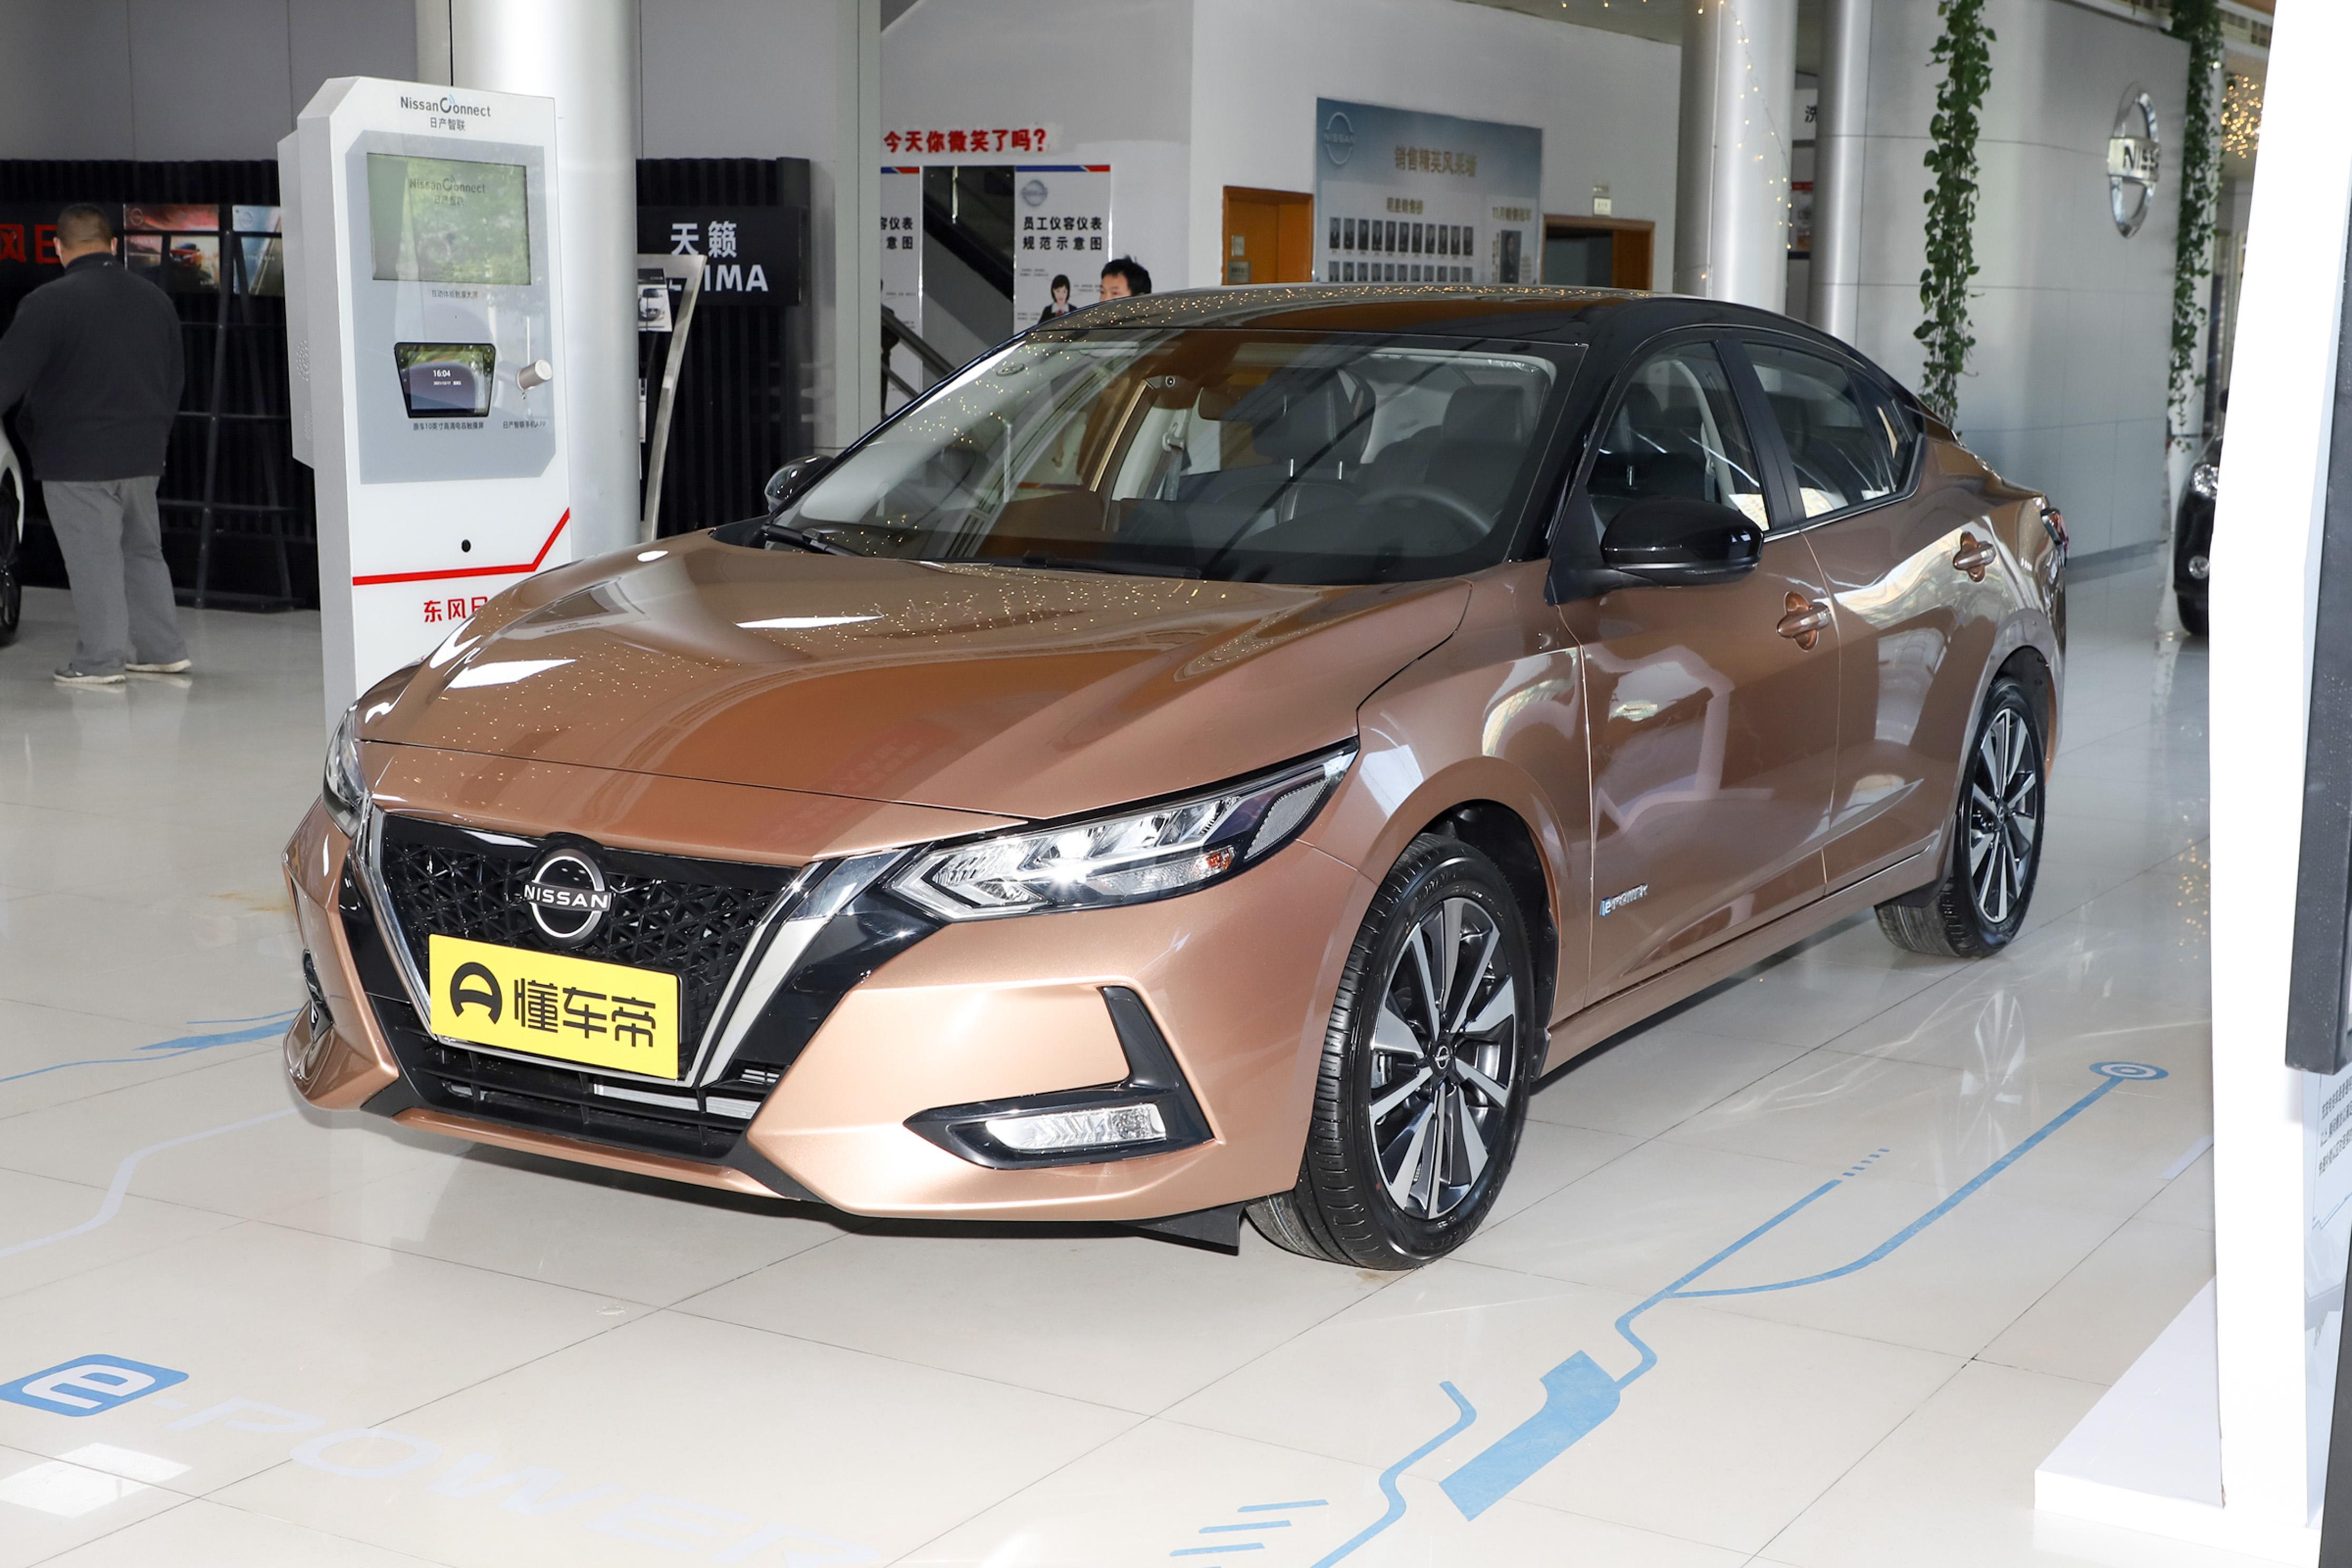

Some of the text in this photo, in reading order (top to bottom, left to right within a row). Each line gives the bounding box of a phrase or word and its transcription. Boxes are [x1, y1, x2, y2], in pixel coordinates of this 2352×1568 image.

[400, 96, 491, 117] NissanConnect
[430, 117, 465, 131] 日产智联
[884, 128, 1046, 153] 今天你微笑了吗？
[409, 178, 486, 193] NissanConnect
[1023, 216, 1102, 230] 员工仪容仪表
[671, 221, 737, 258] 天籁
[1023, 236, 1102, 250] 规范示意图
[524, 884, 608, 908] NISSAN
[514, 978, 656, 1047] 懂车帝
